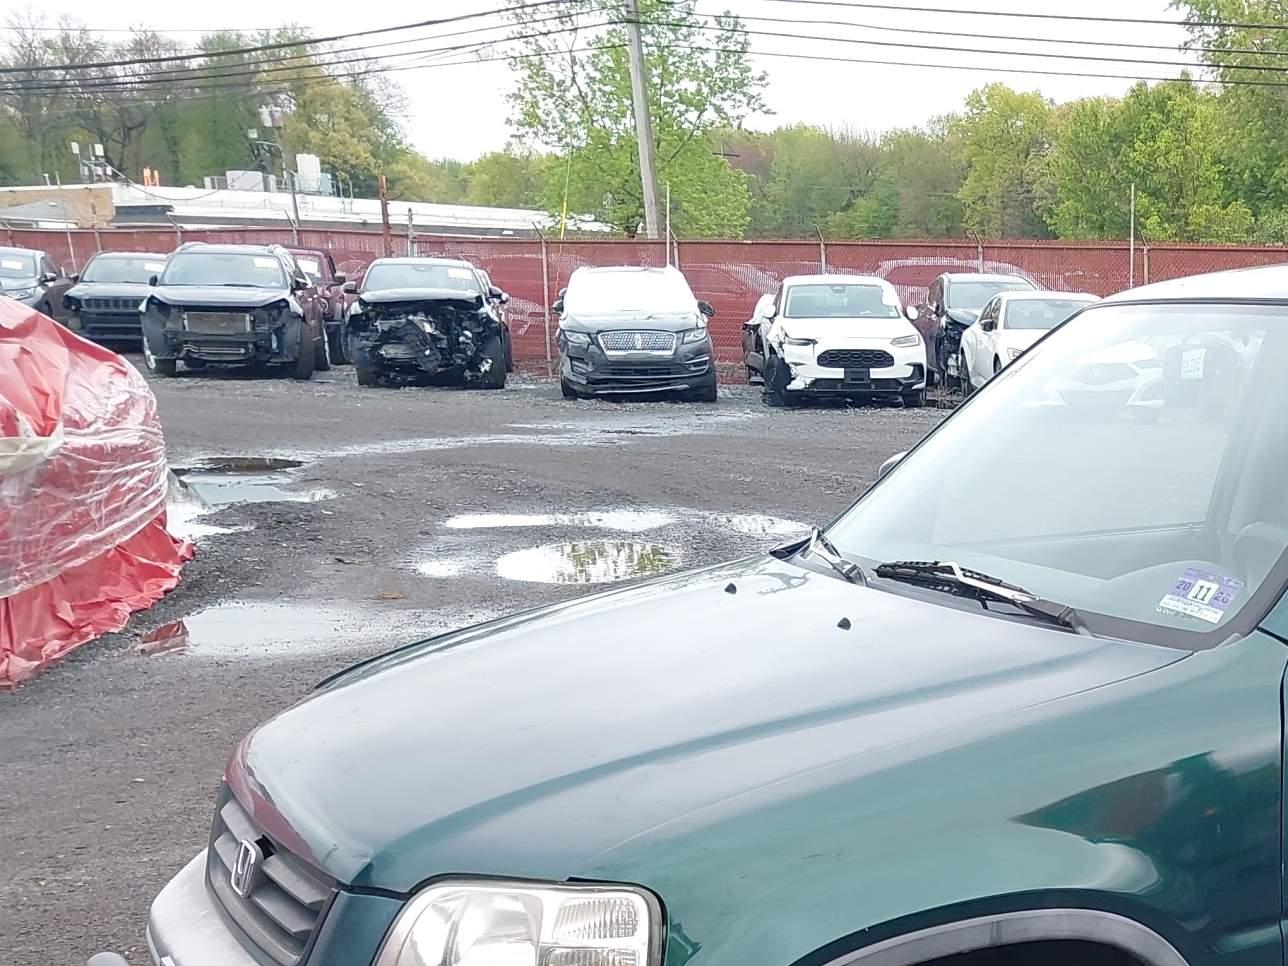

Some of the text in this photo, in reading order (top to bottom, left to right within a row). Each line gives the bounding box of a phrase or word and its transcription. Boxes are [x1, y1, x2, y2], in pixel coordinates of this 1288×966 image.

[1176, 580, 1232, 604] 20 11 26
